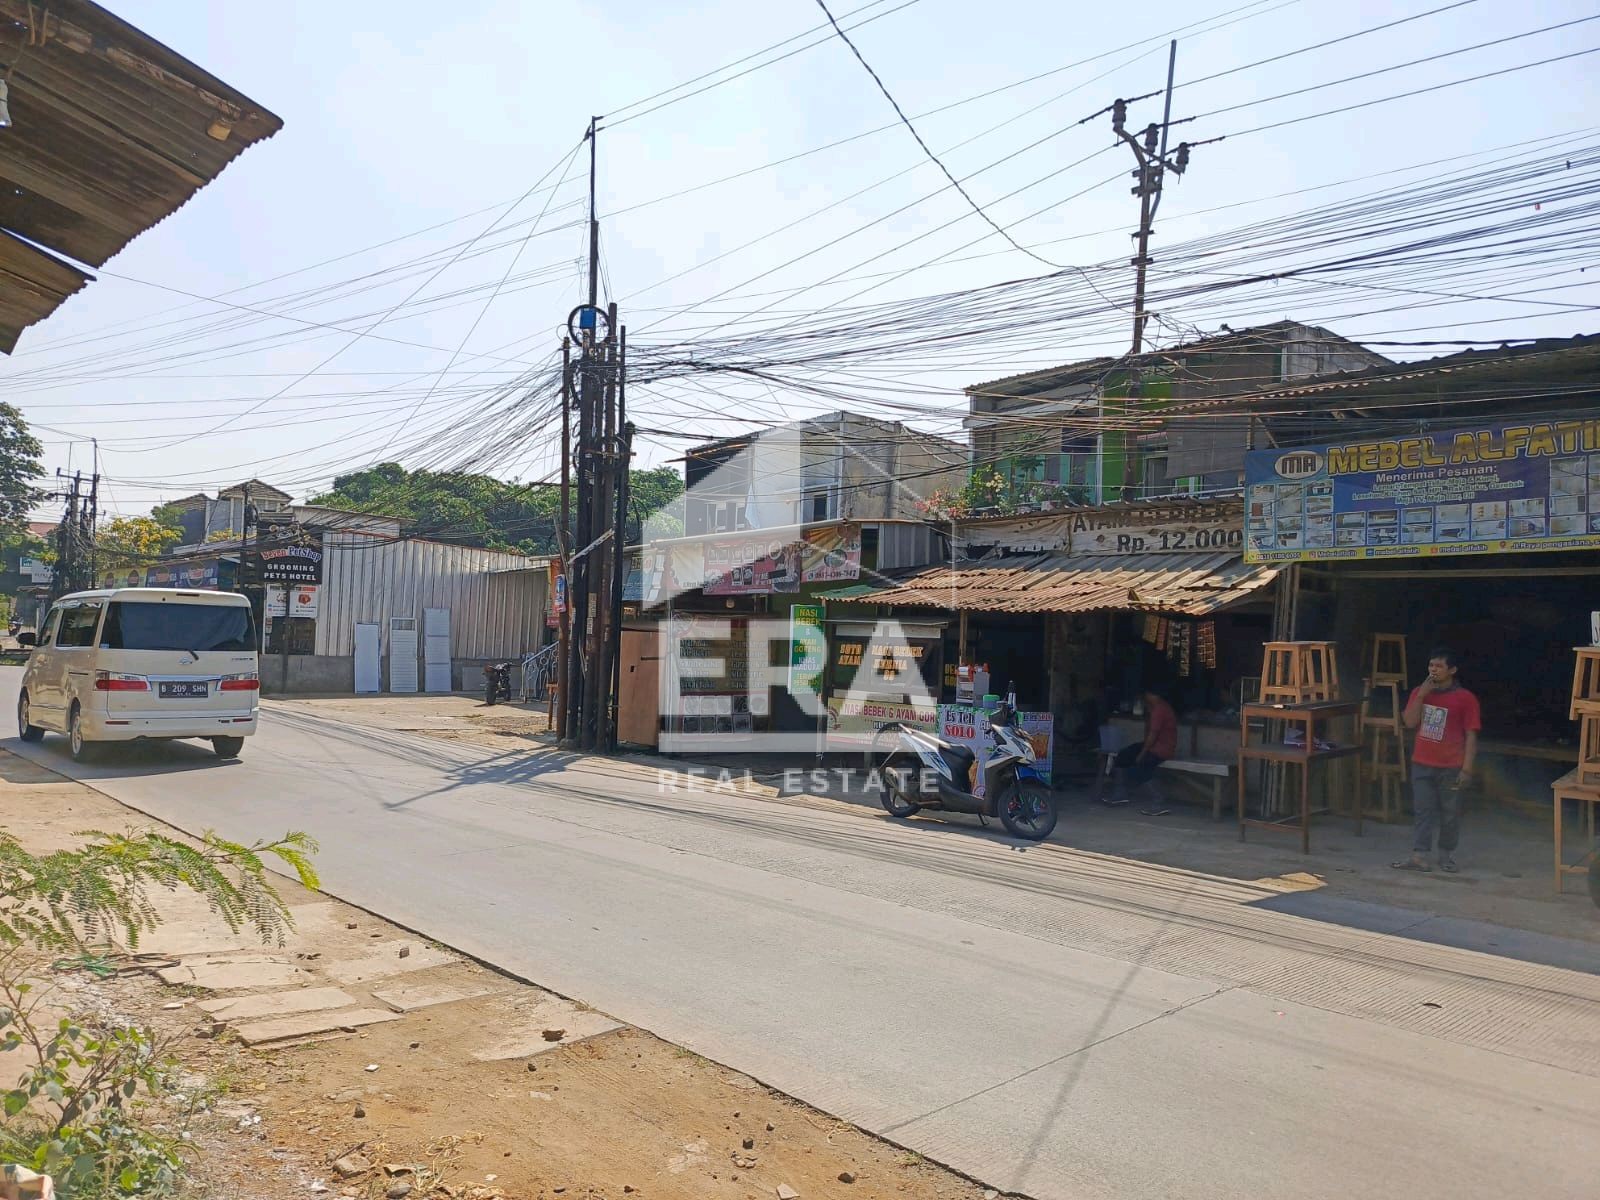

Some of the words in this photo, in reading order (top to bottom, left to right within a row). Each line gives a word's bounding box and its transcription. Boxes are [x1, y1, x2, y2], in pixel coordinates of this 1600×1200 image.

[1327, 436, 1445, 477] MEBEL
[1450, 420, 1600, 465] ALFATI
[1281, 455, 1317, 474] MA
[1376, 471, 1434, 483] Menerima
[1438, 465, 1497, 478] Pesanan:
[1117, 533, 1150, 553] Rp.
[1159, 528, 1243, 550] 12.000
[267, 563, 315, 572] GROOMING
[289, 573, 316, 581] HOTEL
[799, 608, 818, 617] NASI
[838, 655, 861, 665] AYAM
[161, 685, 166, 693] B
[172, 685, 187, 693] 209
[192, 684, 207, 693] SHN
[863, 705, 886, 718] BEBEK
[896, 708, 917, 721] AYAM
[946, 710, 955, 722] Es
[959, 711, 975, 726] Teh
[945, 724, 975, 740] SOLO
